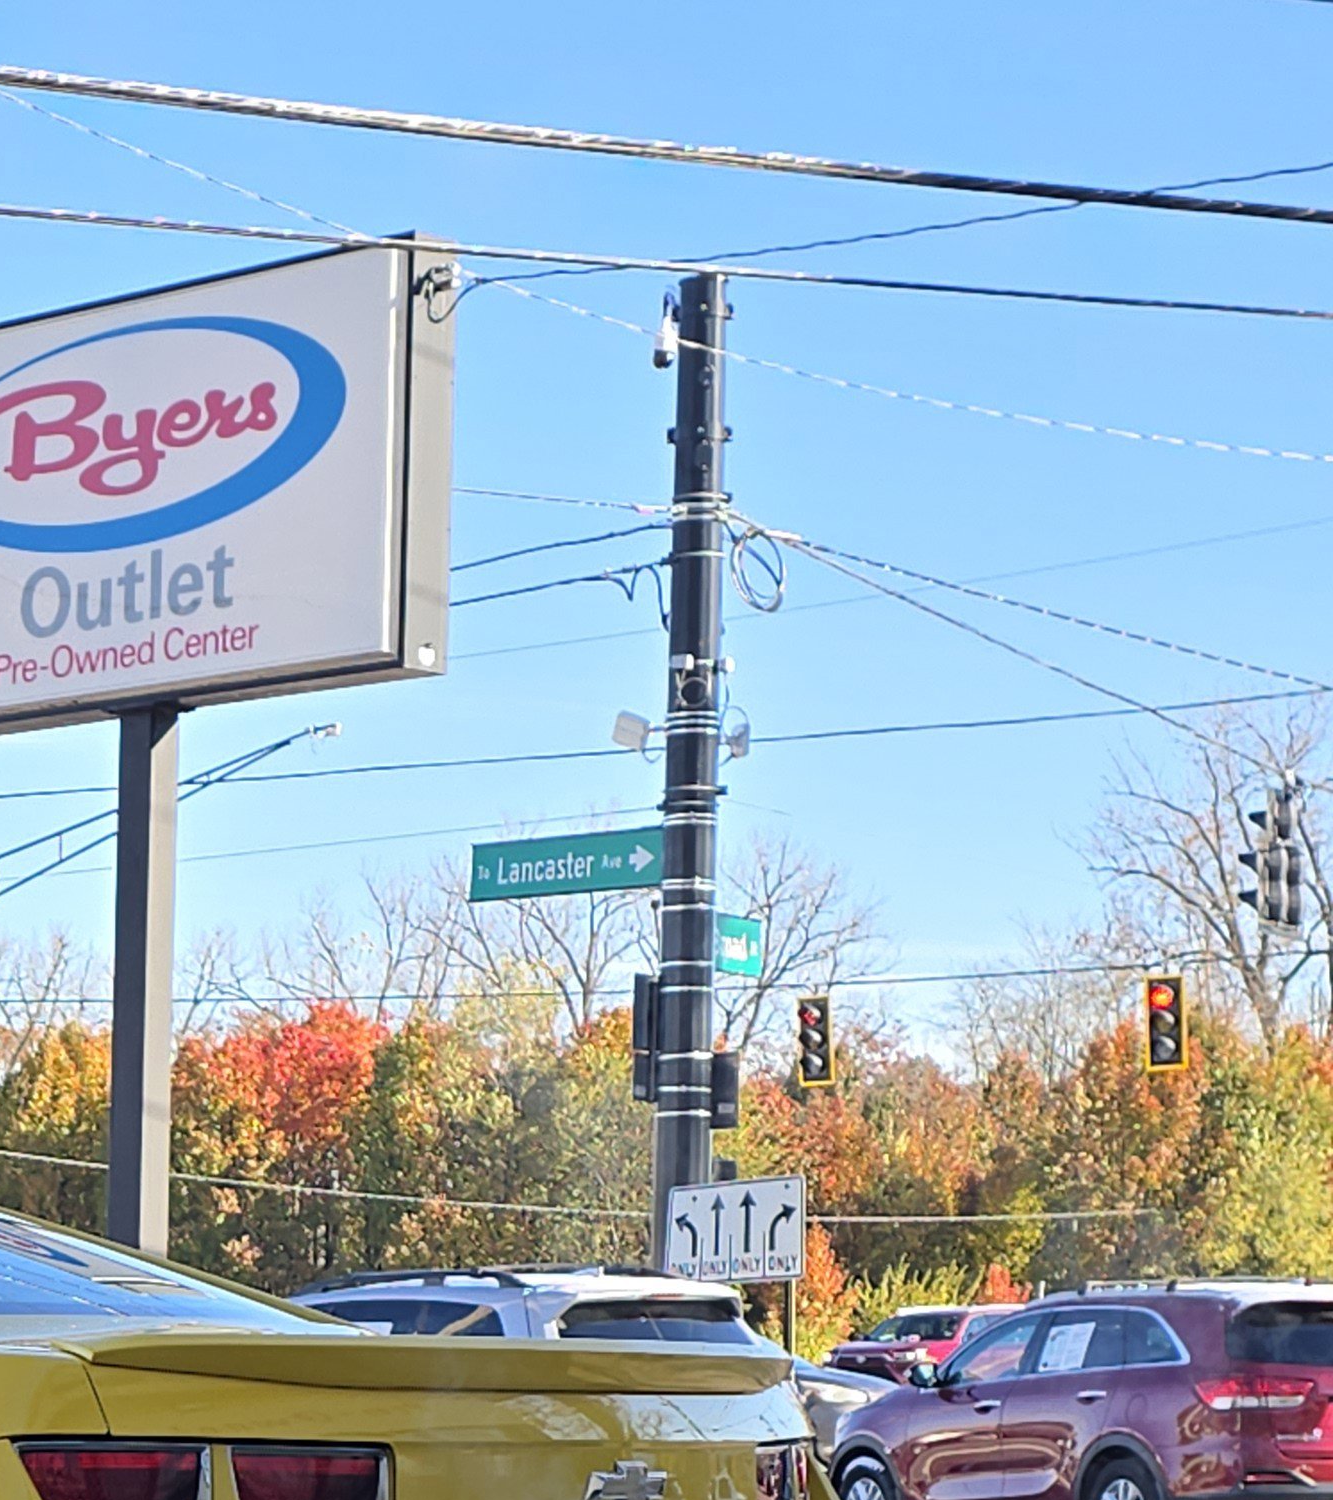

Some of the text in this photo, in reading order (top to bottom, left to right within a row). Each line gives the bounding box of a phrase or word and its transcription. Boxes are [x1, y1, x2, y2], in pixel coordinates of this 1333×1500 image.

[20, 545, 234, 638] Outlet
[164, 620, 259, 661] Center
[477, 851, 622, 885] To Lancaster Ave
[702, 1260, 728, 1276] ONLY
[733, 1257, 761, 1274] ONLY
[768, 1254, 798, 1272] ONLY
